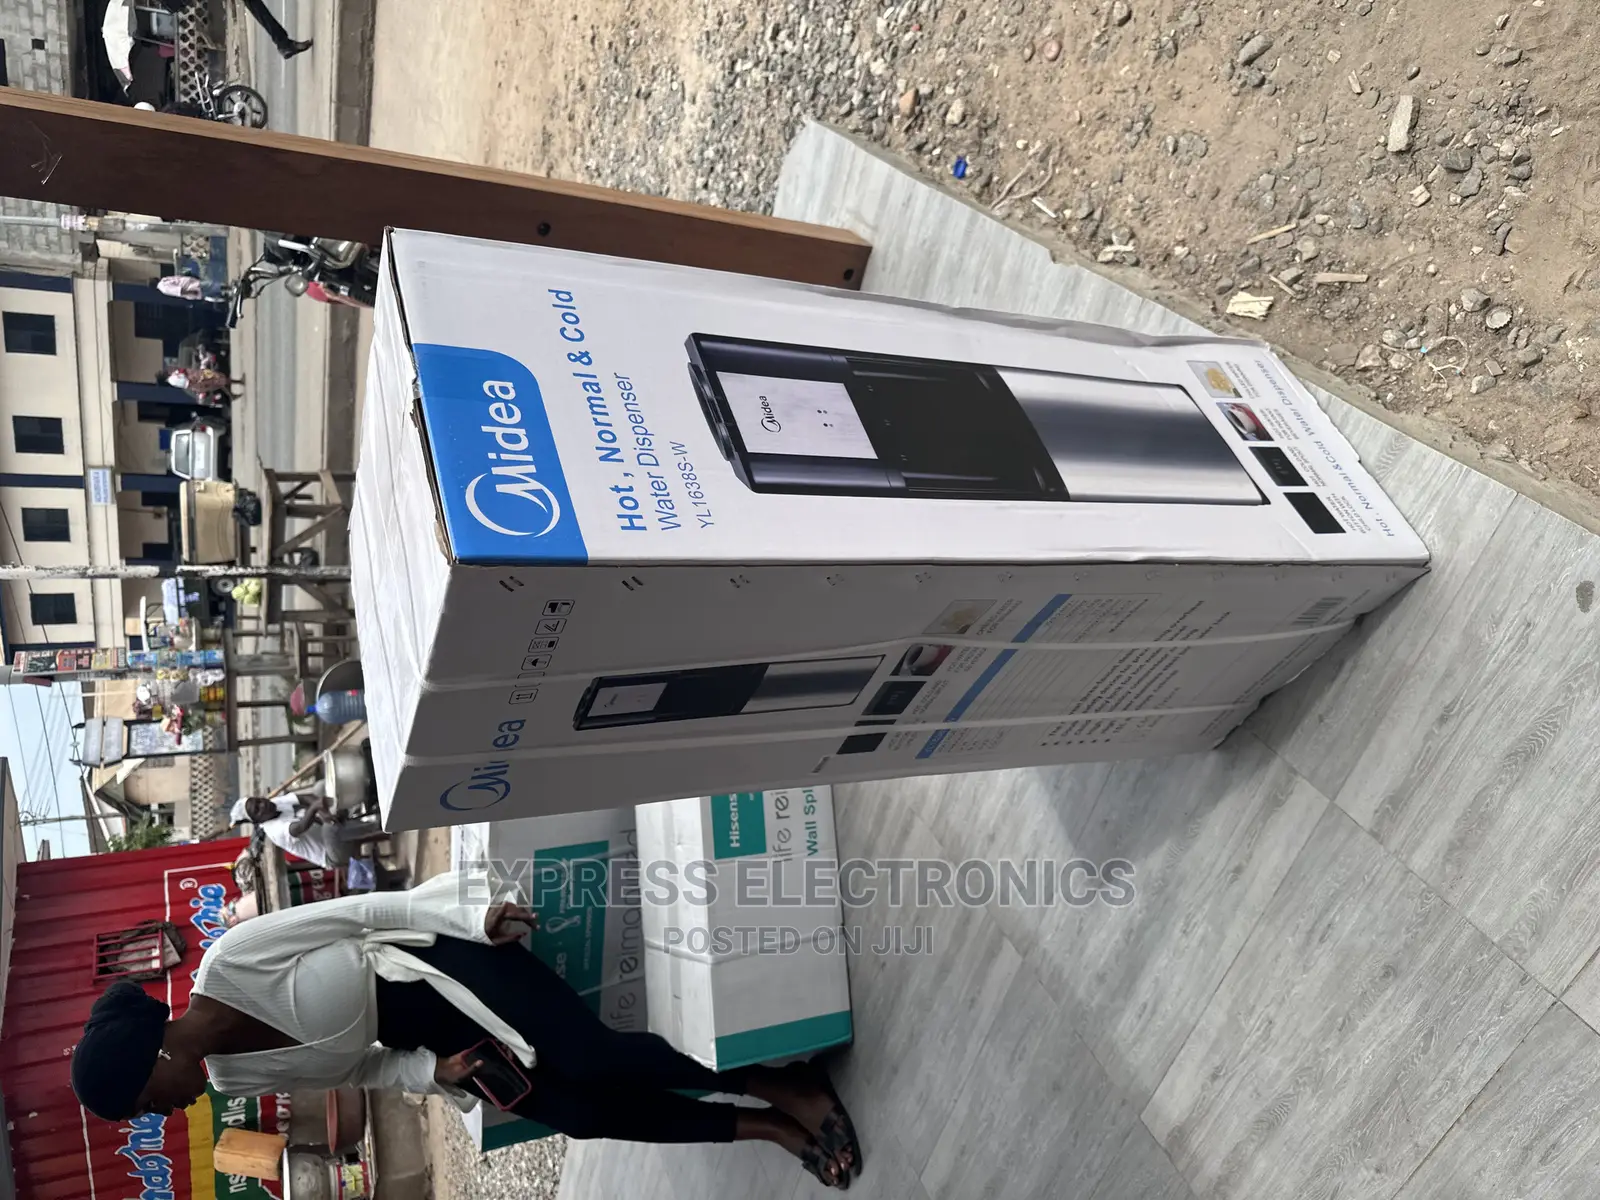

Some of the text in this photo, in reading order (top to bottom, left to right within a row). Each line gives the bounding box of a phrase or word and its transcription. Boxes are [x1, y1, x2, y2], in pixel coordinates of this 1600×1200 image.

[547, 288, 585, 343] Cold
[566, 350, 593, 367] &
[1253, 359, 1293, 406] Dispenser
[572, 372, 624, 464] Normal
[758, 395, 781, 433] Midea
[1290, 408, 1315, 436] Water
[465, 380, 560, 538] Midea
[613, 372, 682, 531] Water Dispenser
[609, 484, 647, 532] Hot
[669, 441, 715, 529] YL1638S-W
[1338, 472, 1373, 510] Normal
[728, 793, 740, 848] Hisens
[771, 827, 793, 863] life
[801, 789, 819, 857] Wall Spl
